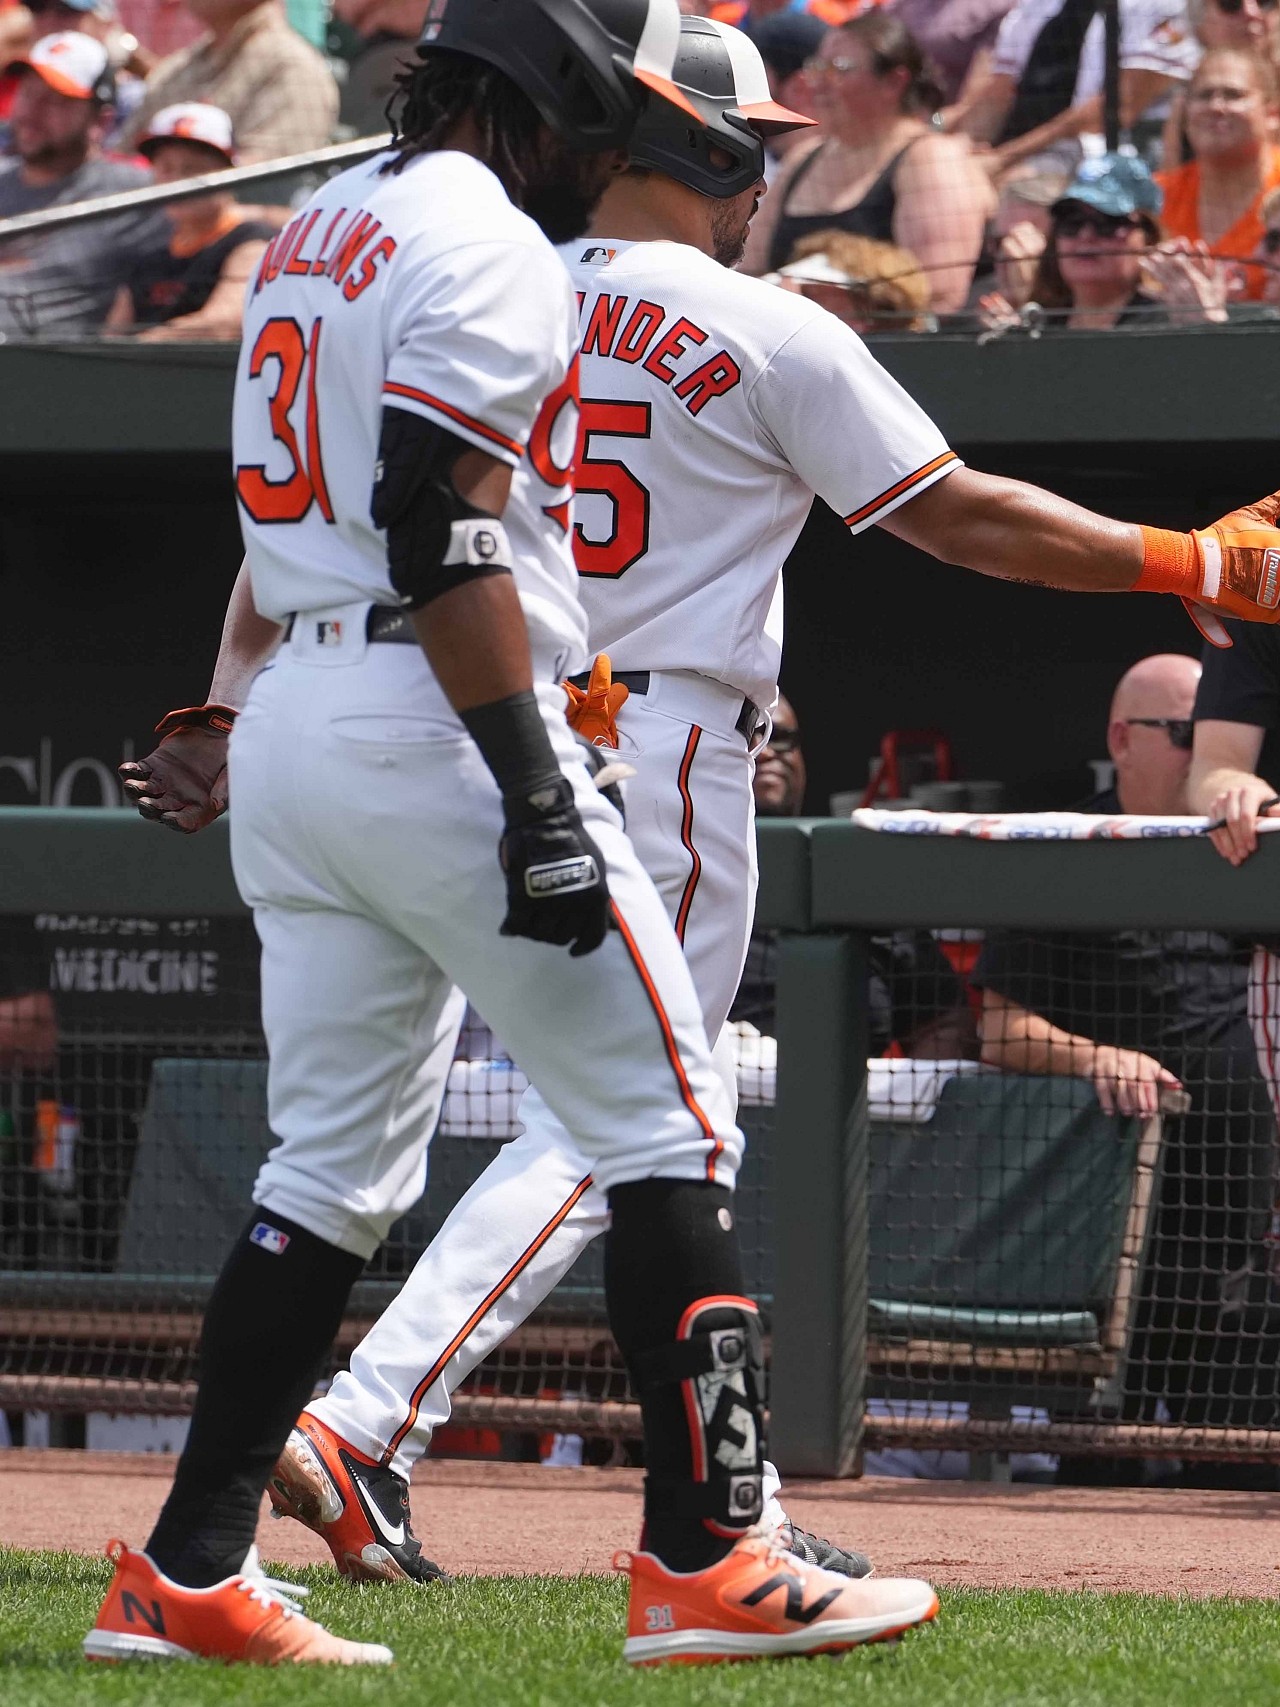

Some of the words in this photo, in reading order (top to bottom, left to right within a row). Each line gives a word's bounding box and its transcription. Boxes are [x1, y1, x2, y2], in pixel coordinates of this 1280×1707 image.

[576, 290, 742, 417] NDER
[237, 316, 336, 524] 31
[645, 1605, 675, 1630] 31
